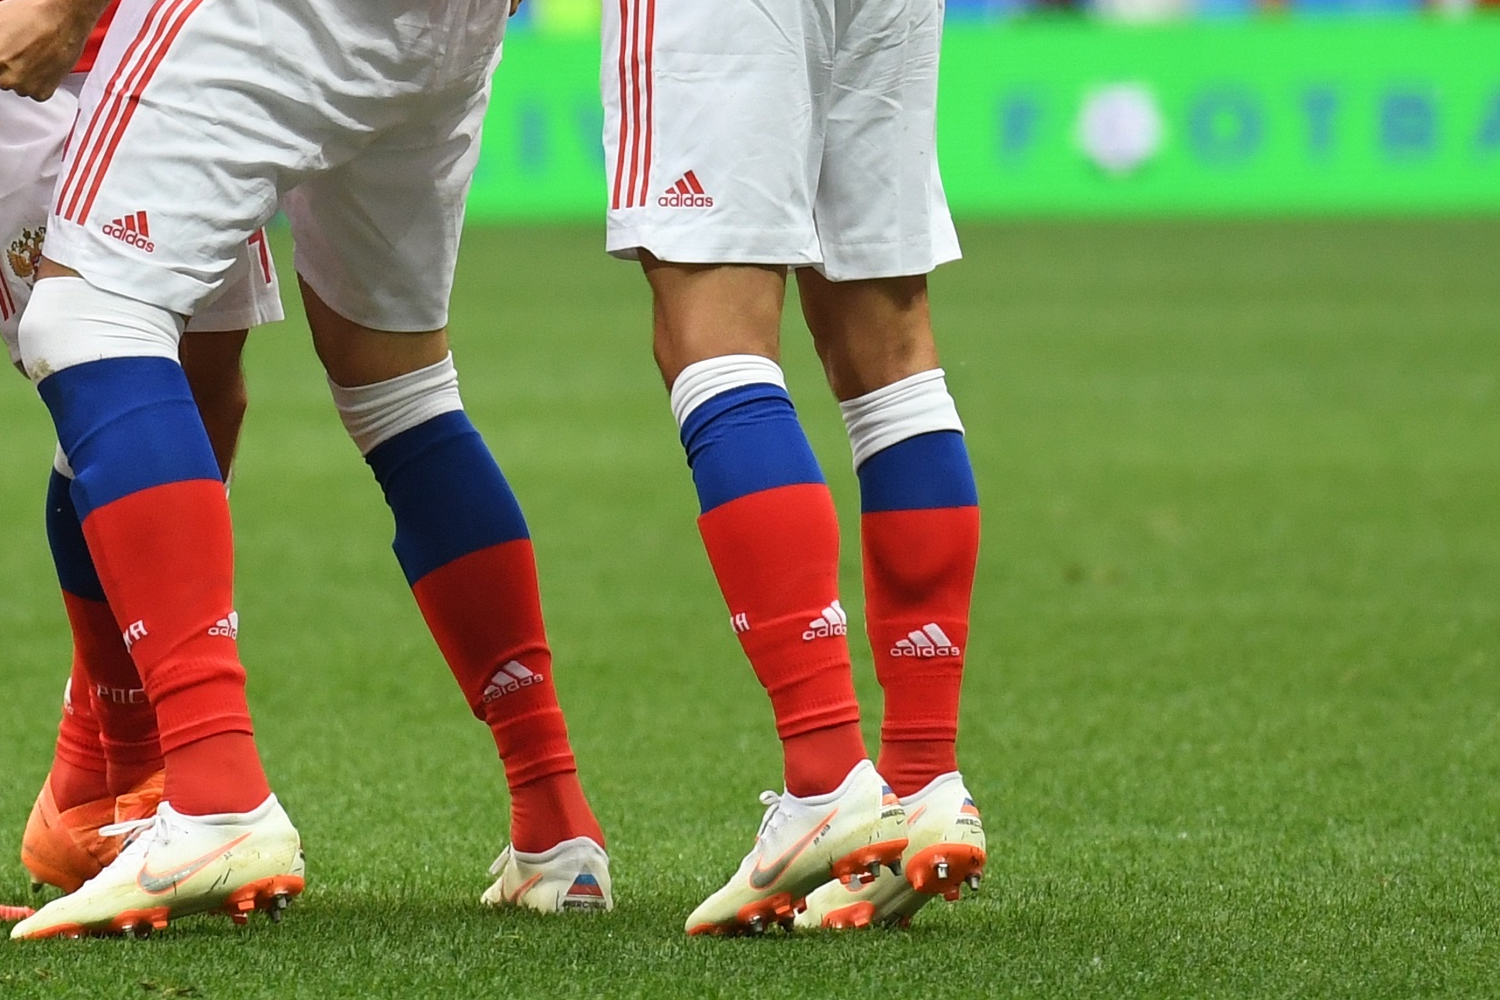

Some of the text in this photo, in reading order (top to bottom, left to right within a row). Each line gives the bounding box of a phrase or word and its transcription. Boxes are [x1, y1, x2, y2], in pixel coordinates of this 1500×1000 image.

[658, 193, 713, 207] adidas
[102, 224, 155, 253] adidas
[207, 623, 238, 640] adid
[889, 645, 960, 657] adidas
[483, 673, 544, 703] adidas
